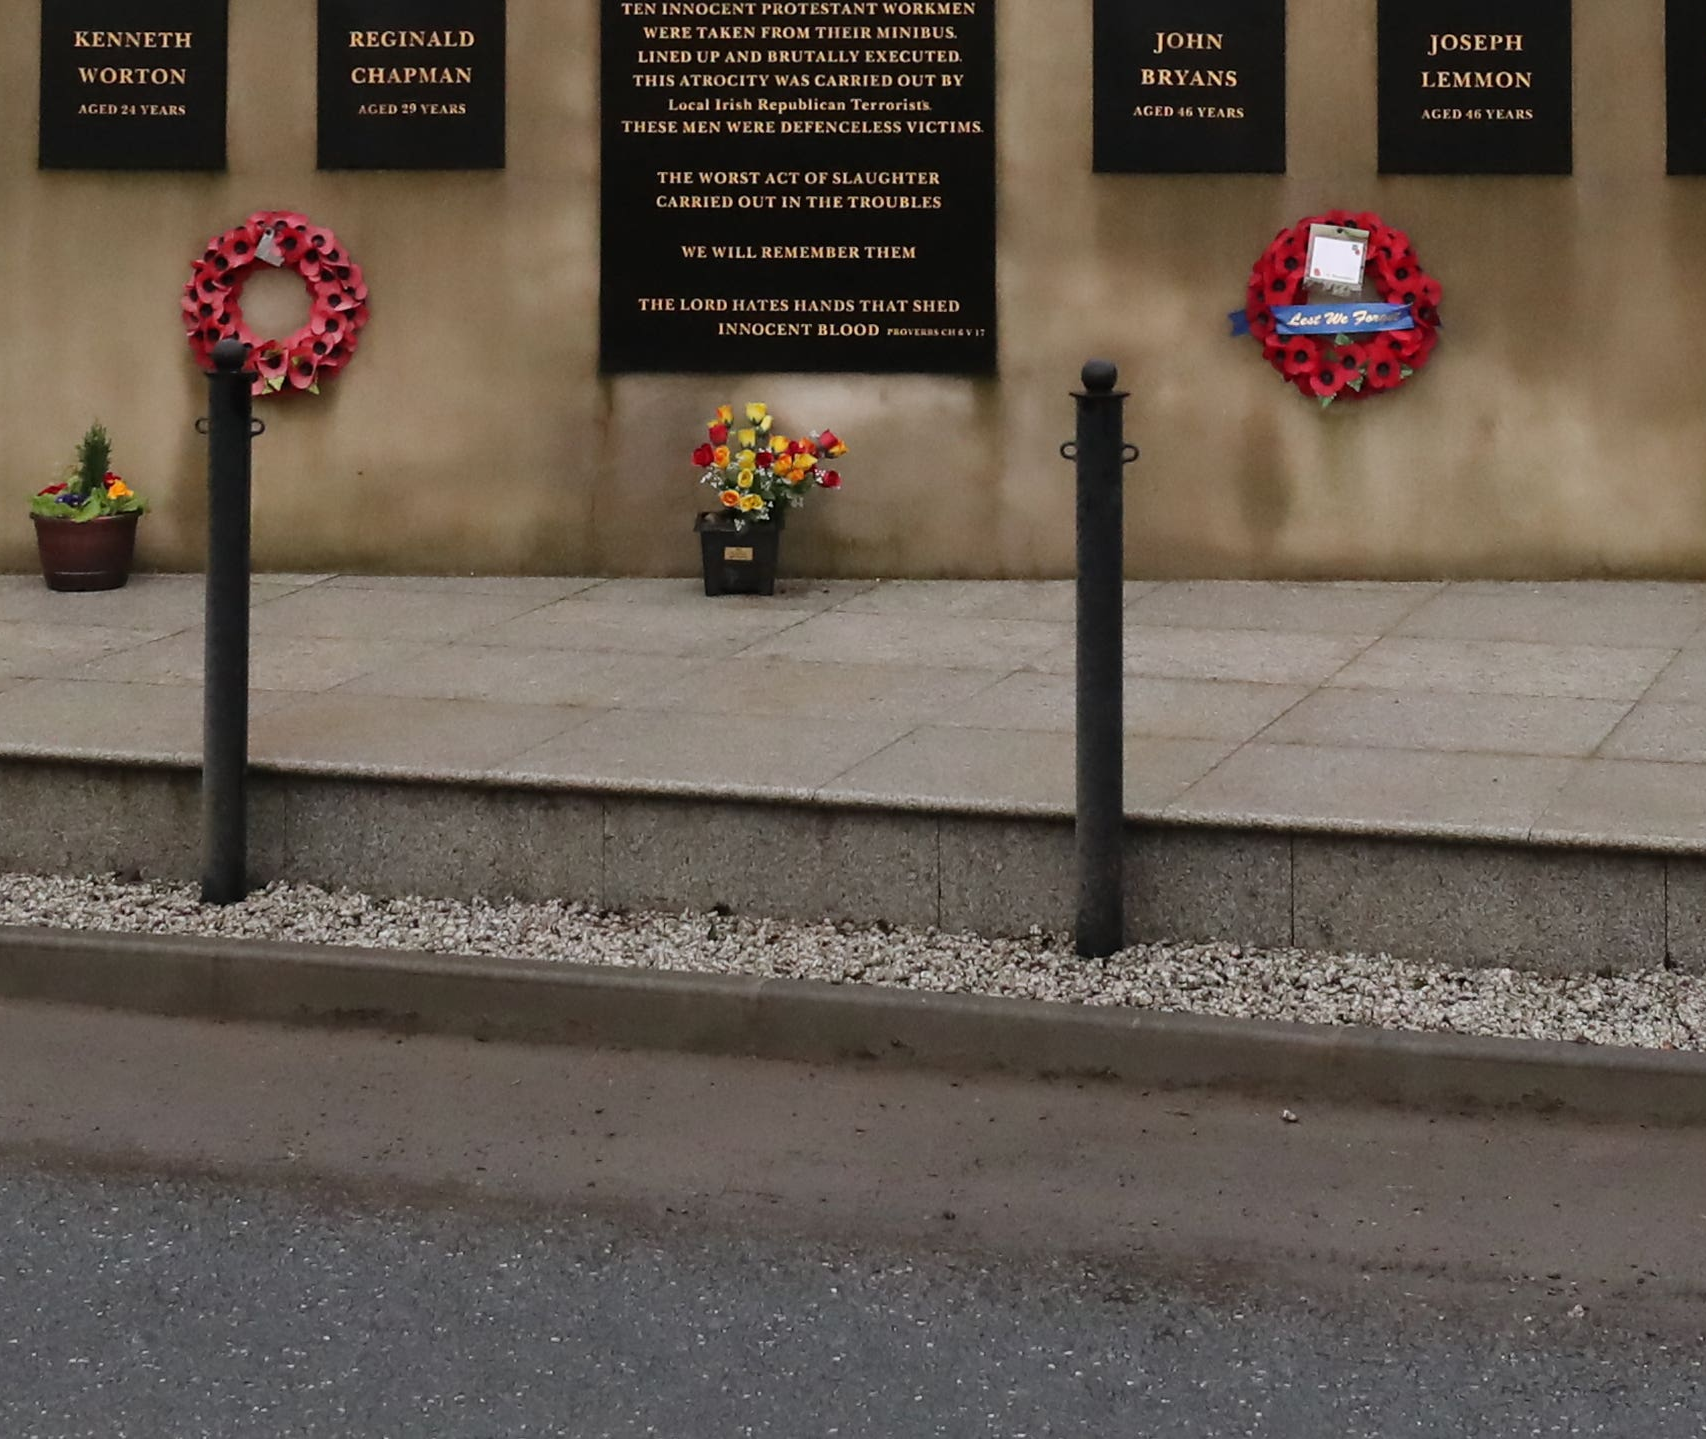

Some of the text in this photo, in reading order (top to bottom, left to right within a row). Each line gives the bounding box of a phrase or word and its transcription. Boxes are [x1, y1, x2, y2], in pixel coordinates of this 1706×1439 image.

[621, 2, 975, 15] TEN INNOCENT PROTESTANT WORKMEN
[349, 31, 474, 47] REGINALD
[643, 27, 692, 39] WERE
[696, 26, 755, 39] TAKEN
[761, 26, 810, 39] FROM
[815, 27, 872, 39] THEIR
[74, 31, 192, 48] KENNETH
[1153, 32, 1223, 54] JOHN
[1427, 34, 1523, 56] JOSEPH
[638, 50, 962, 63] LINED UP AND BRUTALLY EXECUTED.
[78, 67, 186, 84] WORTON
[351, 67, 471, 84] CHAPMAN
[633, 74, 964, 87] THIS ATROCITY WAS CARRIED OUT BY
[1141, 69, 1237, 87] BRYANS
[1422, 71, 1532, 88] LEMMON
[78, 104, 185, 115] AGED 24 YEARS
[359, 103, 466, 114] AGED 29 YEARS
[669, 98, 709, 111] Local
[715, 98, 752, 110] Irish
[758, 98, 845, 114] Republican
[1133, 106, 1244, 118] AGED 46 YEARS
[1422, 109, 1533, 119] AGED 46 YEARS
[621, 121, 678, 133] THESE
[683, 121, 720, 133] MEN
[726, 121, 775, 133] WERE
[781, 121, 901, 133] DEFENCELESS
[657, 172, 939, 184] THE WORST ACT OF SLAUGHTER
[656, 195, 941, 208] CARRIED OUT IN THE TROUBLES
[682, 246, 915, 258] WE WILL REMEMBER THEM
[638, 298, 960, 312] THE LORD HATES HANDS THAT SHED
[1288, 312, 1321, 326] Lest
[1324, 311, 1350, 325] We
[719, 323, 812, 335] INNOCENT
[818, 323, 879, 336] BLOOD
[887, 328, 939, 336] PROVERBS
[941, 328, 956, 336] CH
